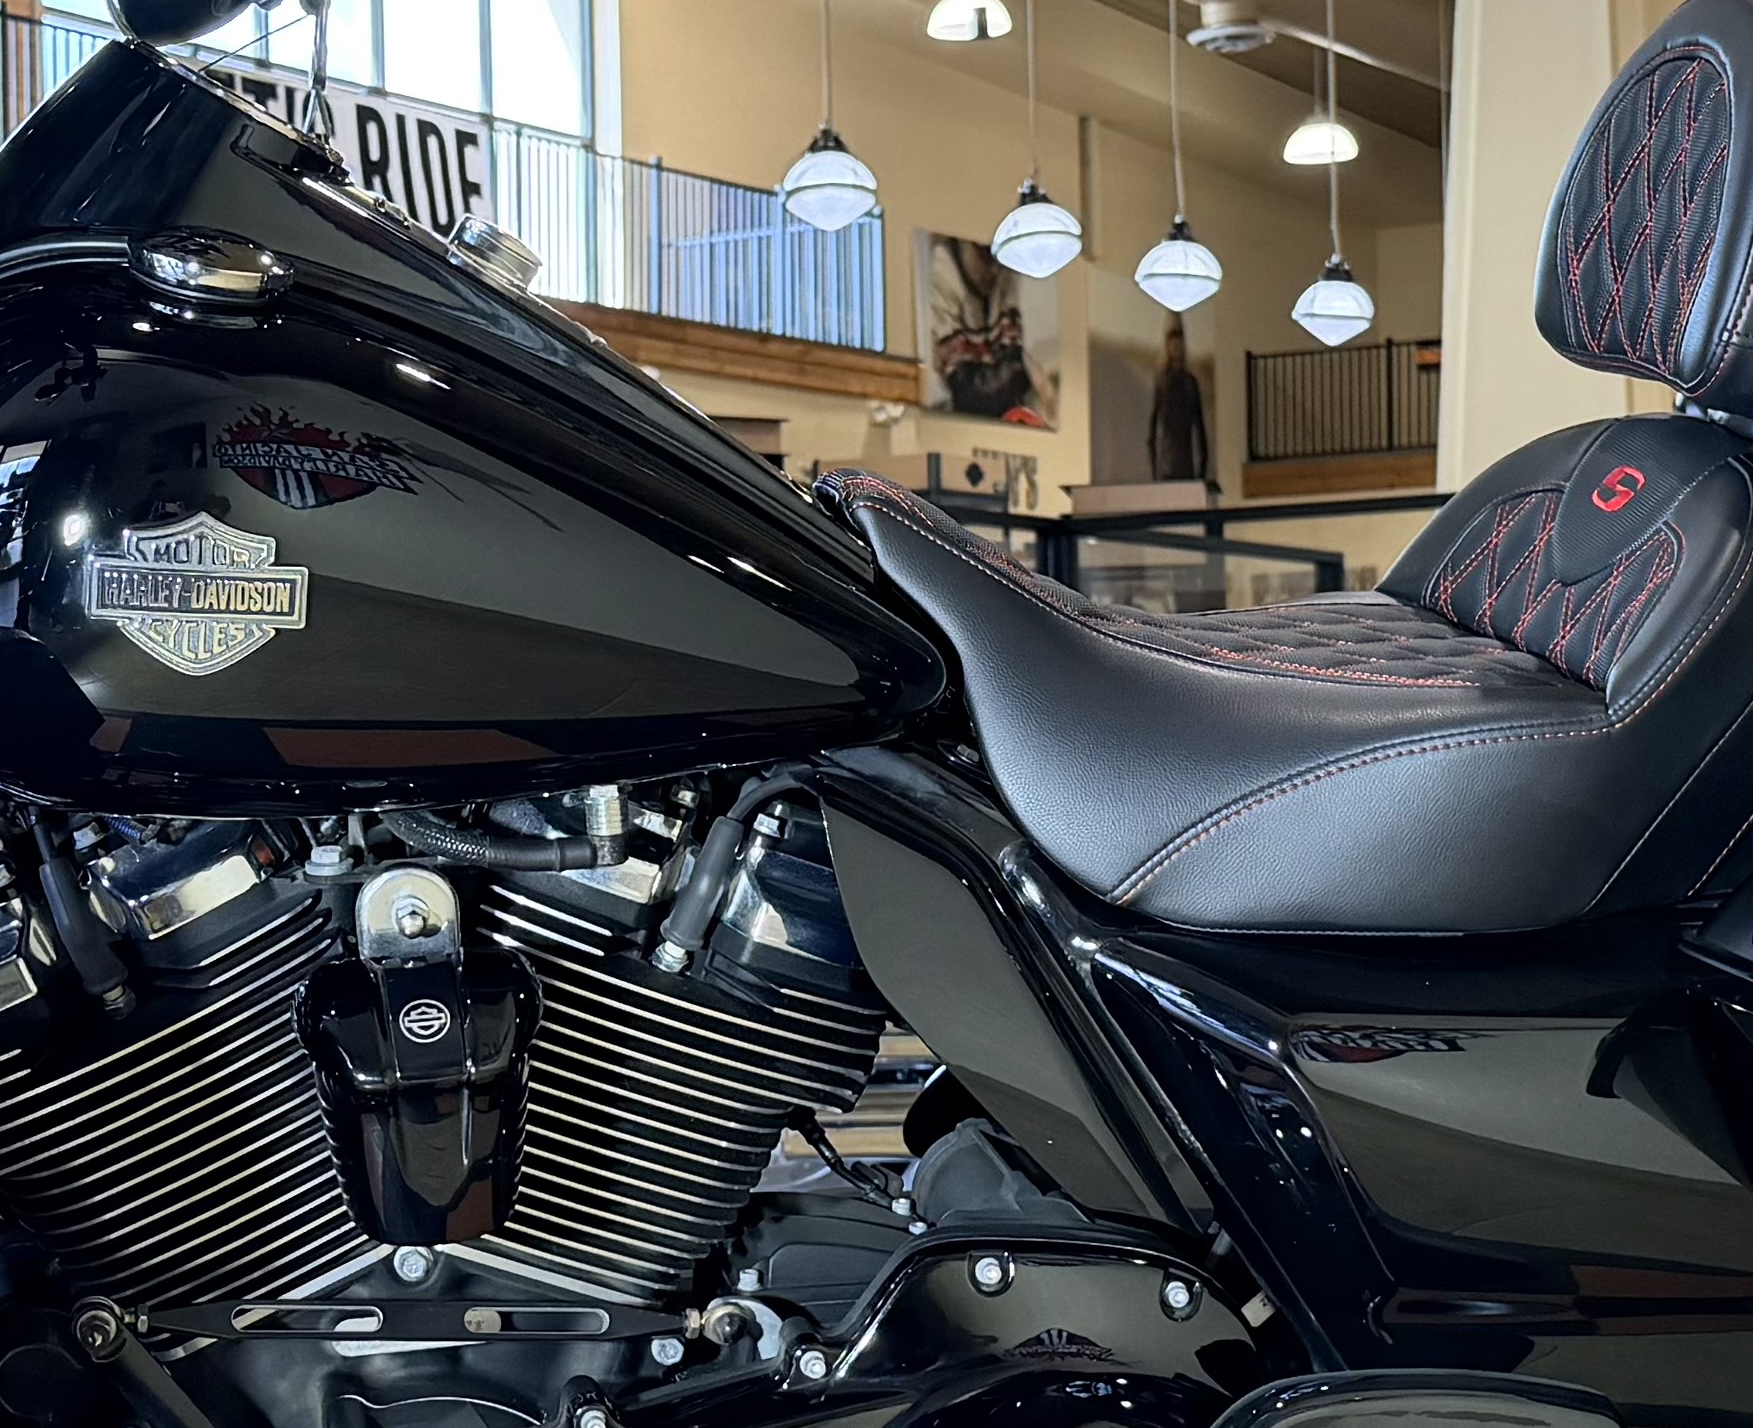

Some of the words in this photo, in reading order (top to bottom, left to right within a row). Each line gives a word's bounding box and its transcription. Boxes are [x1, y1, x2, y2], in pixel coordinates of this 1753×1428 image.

[355, 103, 483, 238] RIDE
[151, 534, 250, 568] MOTOR
[104, 572, 291, 613] HARLEY-DAVIDSON
[148, 620, 246, 660] CYCLES
